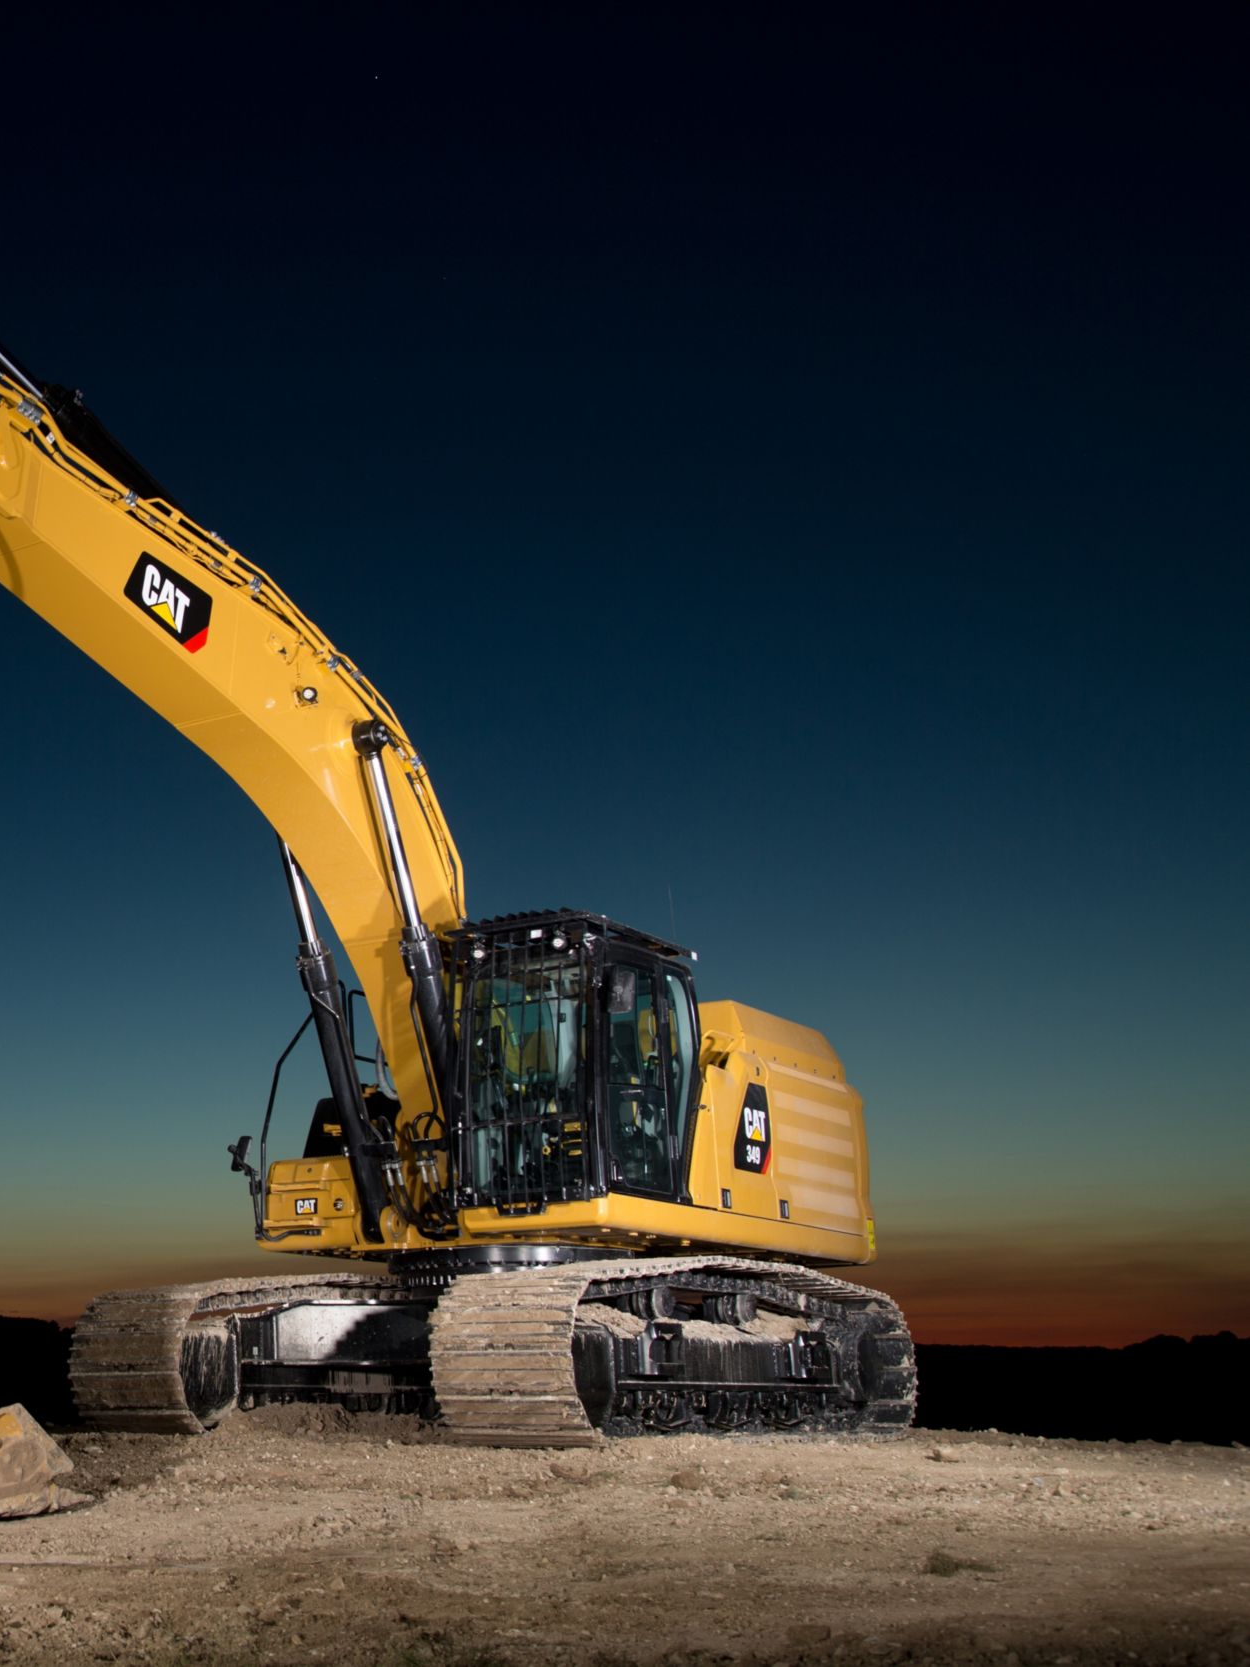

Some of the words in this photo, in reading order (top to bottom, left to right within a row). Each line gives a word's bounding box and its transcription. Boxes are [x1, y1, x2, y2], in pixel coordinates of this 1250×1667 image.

[141, 564, 190, 633] CAT
[743, 1107, 766, 1142] CAT
[746, 1144, 761, 1165] 349
[296, 1199, 316, 1214] CAT
